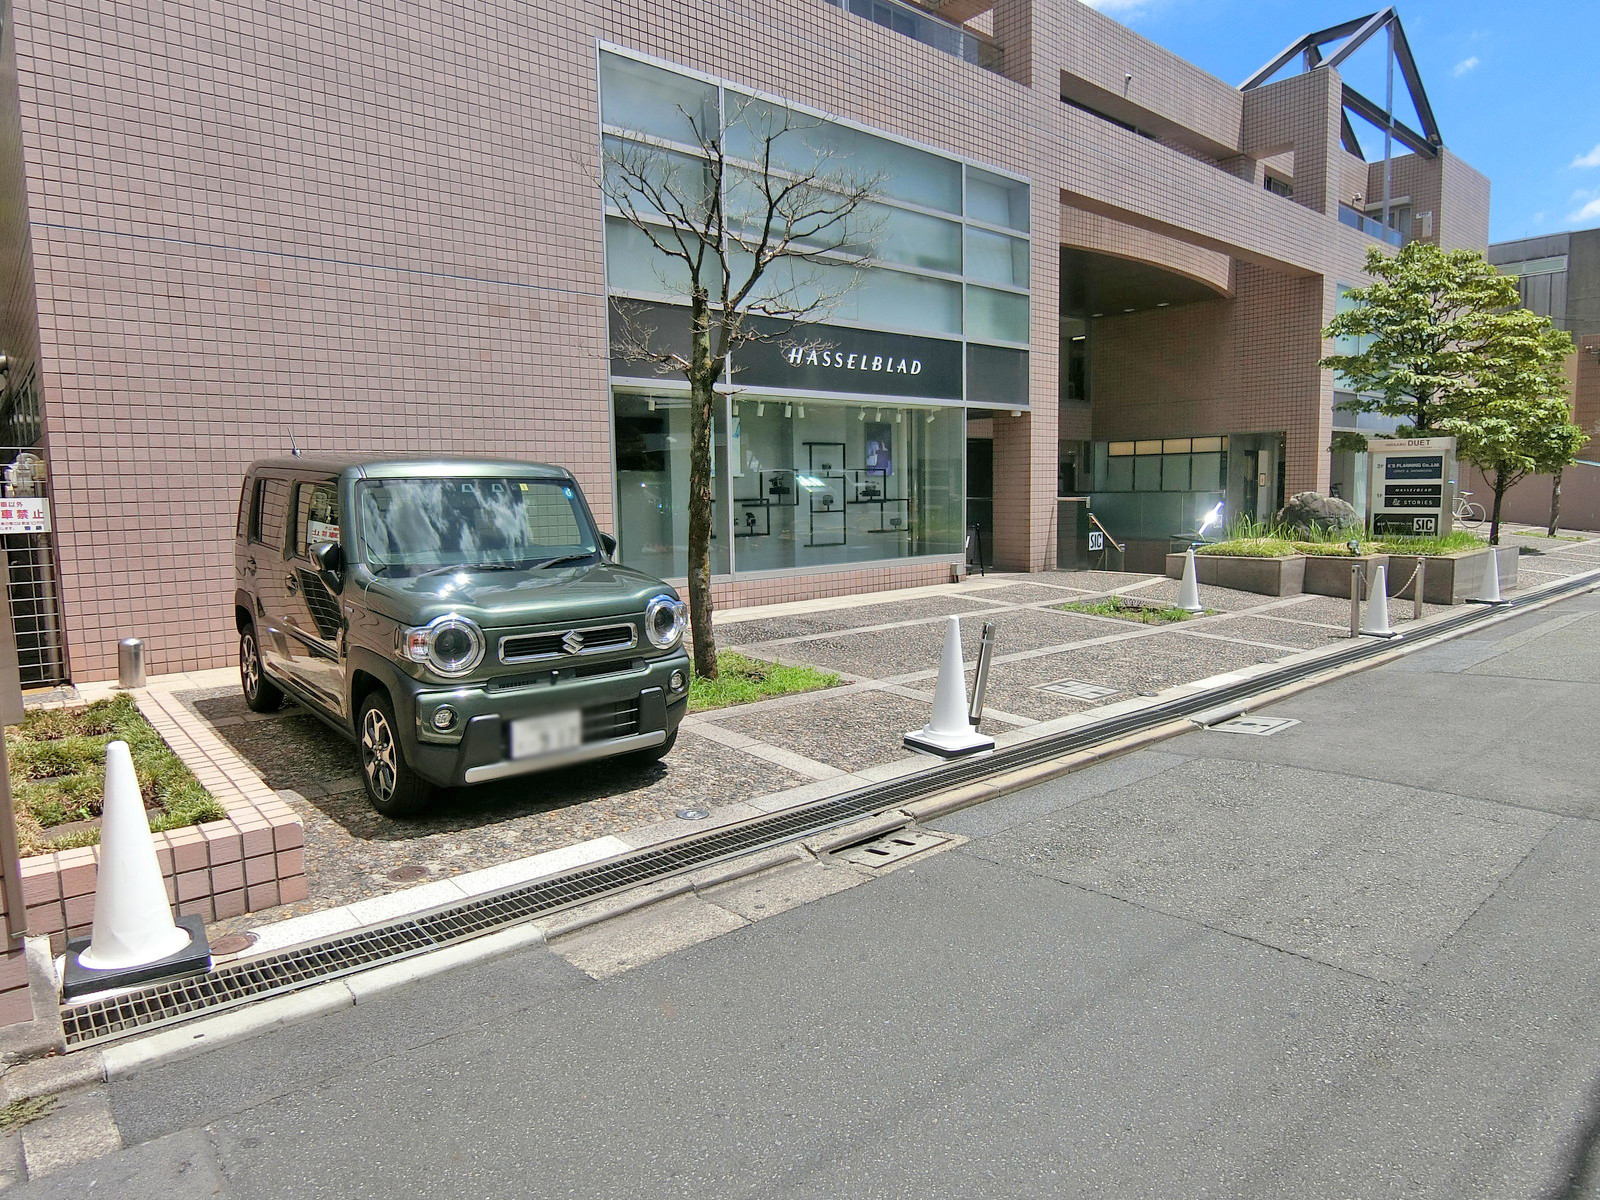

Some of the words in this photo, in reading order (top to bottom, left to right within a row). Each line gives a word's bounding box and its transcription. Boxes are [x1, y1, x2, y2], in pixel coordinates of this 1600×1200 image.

[788, 347, 922, 375] HASSELBLAD
[1407, 439, 1431, 447] DUET
[1415, 519, 1433, 531] SIC
[1090, 533, 1102, 549] SIC
